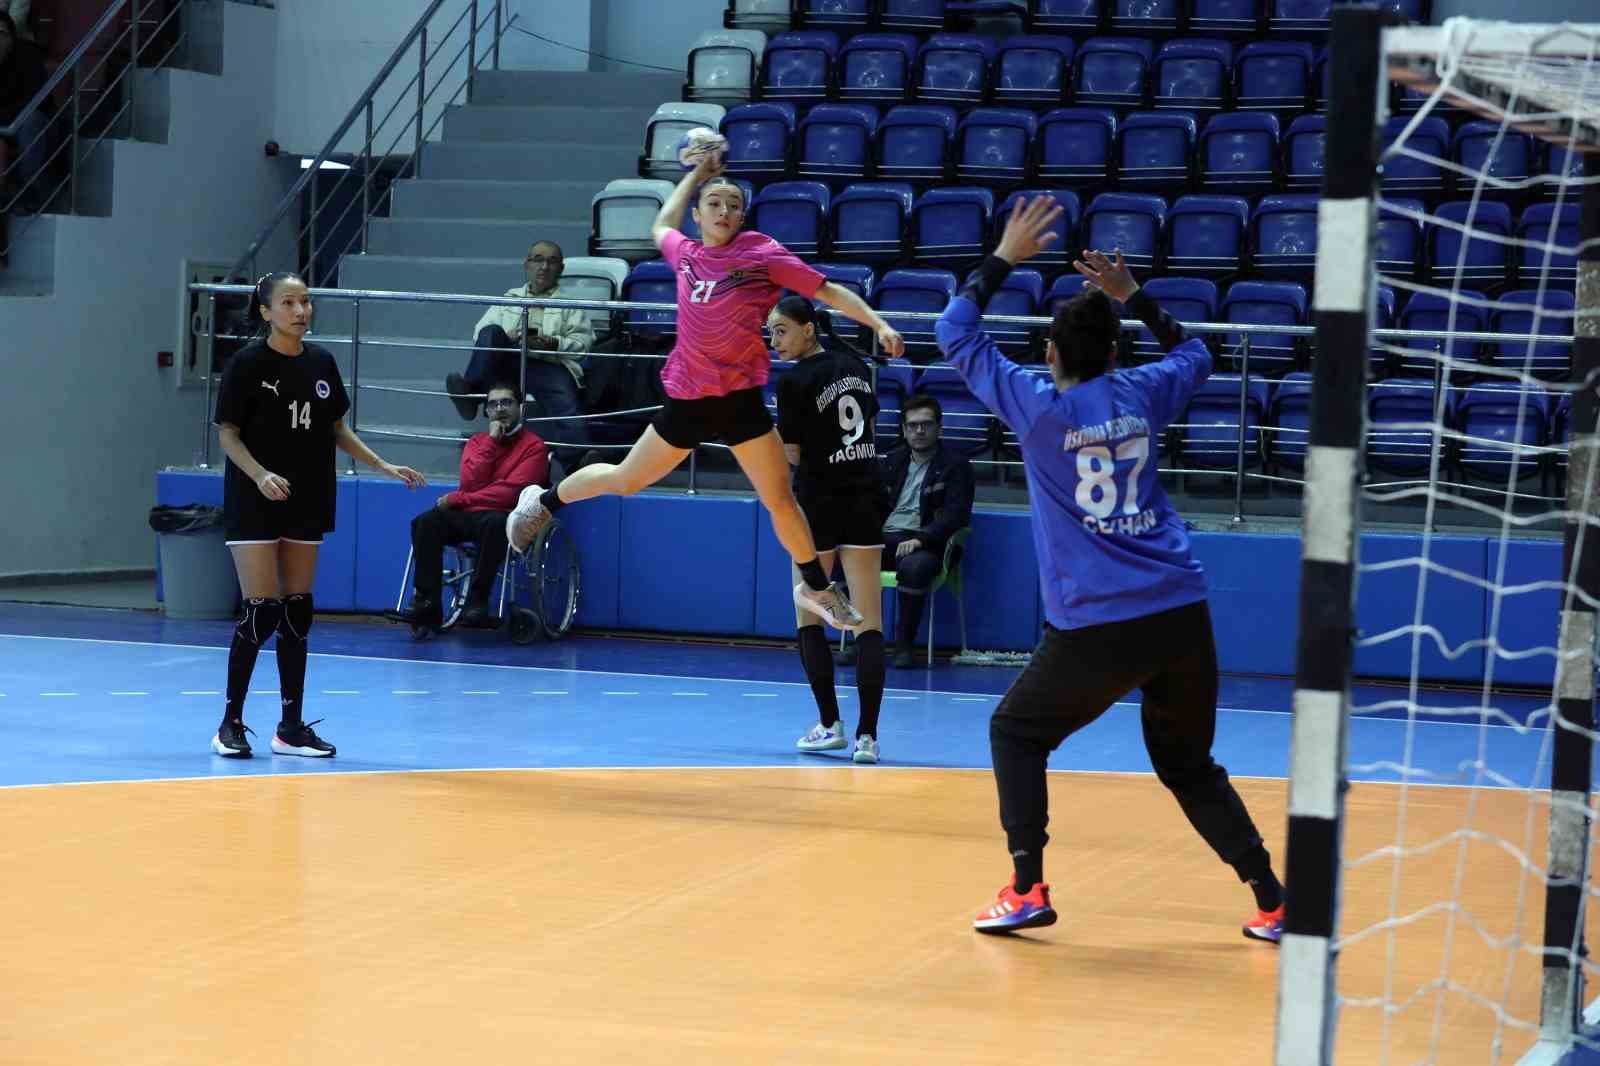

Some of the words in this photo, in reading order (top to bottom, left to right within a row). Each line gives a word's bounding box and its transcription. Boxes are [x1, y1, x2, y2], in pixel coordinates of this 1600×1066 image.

[691, 280, 717, 303] 27
[288, 400, 312, 430] 14
[839, 394, 864, 446] 9
[1075, 436, 1149, 520] 87
